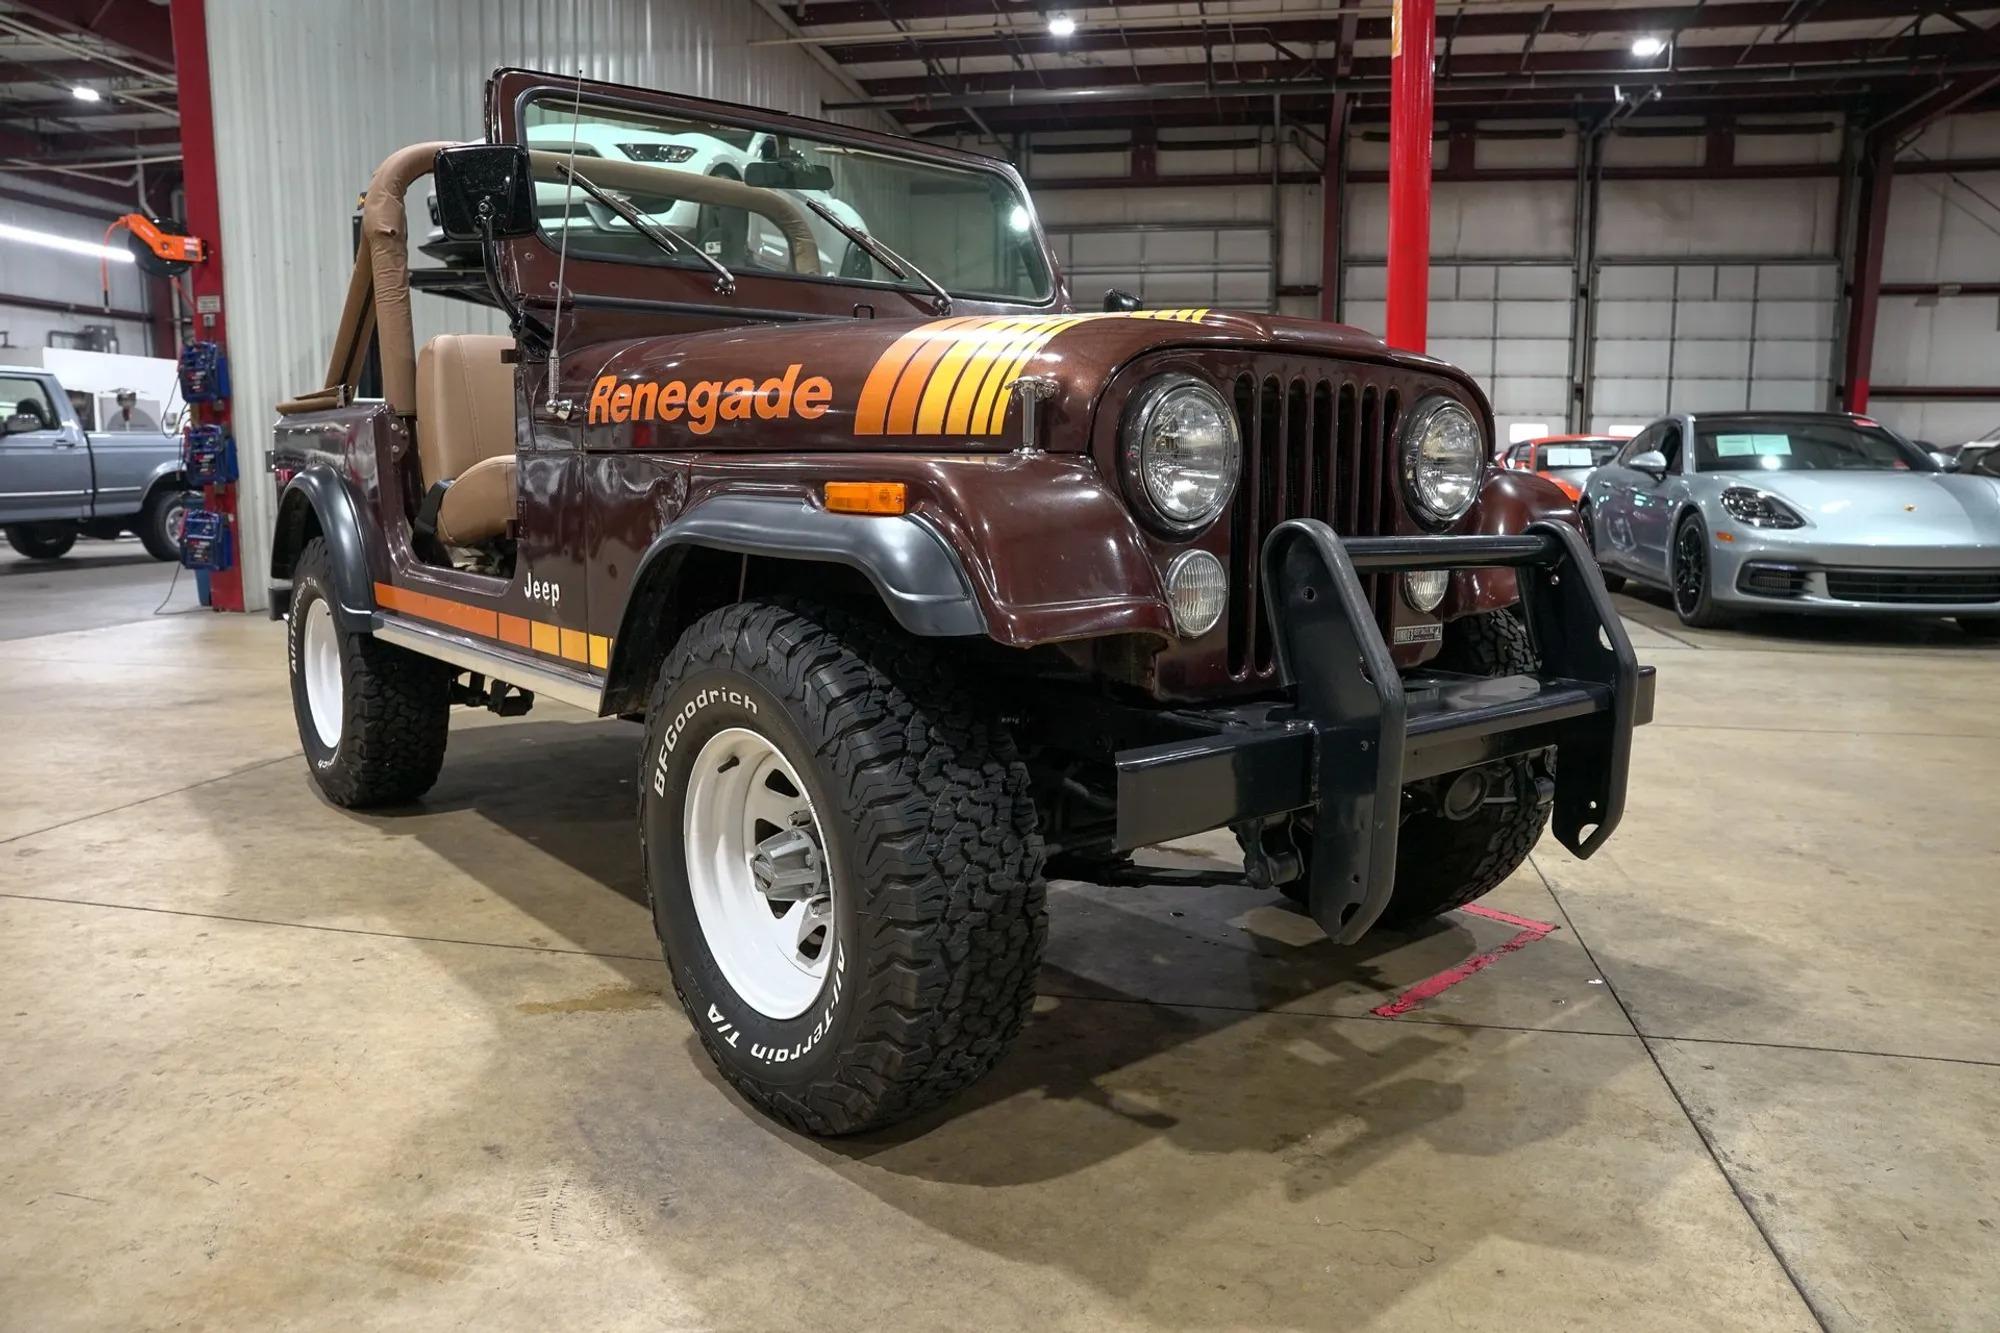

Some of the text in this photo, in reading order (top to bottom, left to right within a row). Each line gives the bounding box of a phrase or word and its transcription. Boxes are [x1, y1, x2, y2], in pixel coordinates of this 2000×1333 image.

[588, 364, 833, 435] Renegade
[523, 572, 560, 606] Jeep
[654, 686, 758, 798] BFGoodrich
[707, 939, 845, 1065] All-Terrain T/A
